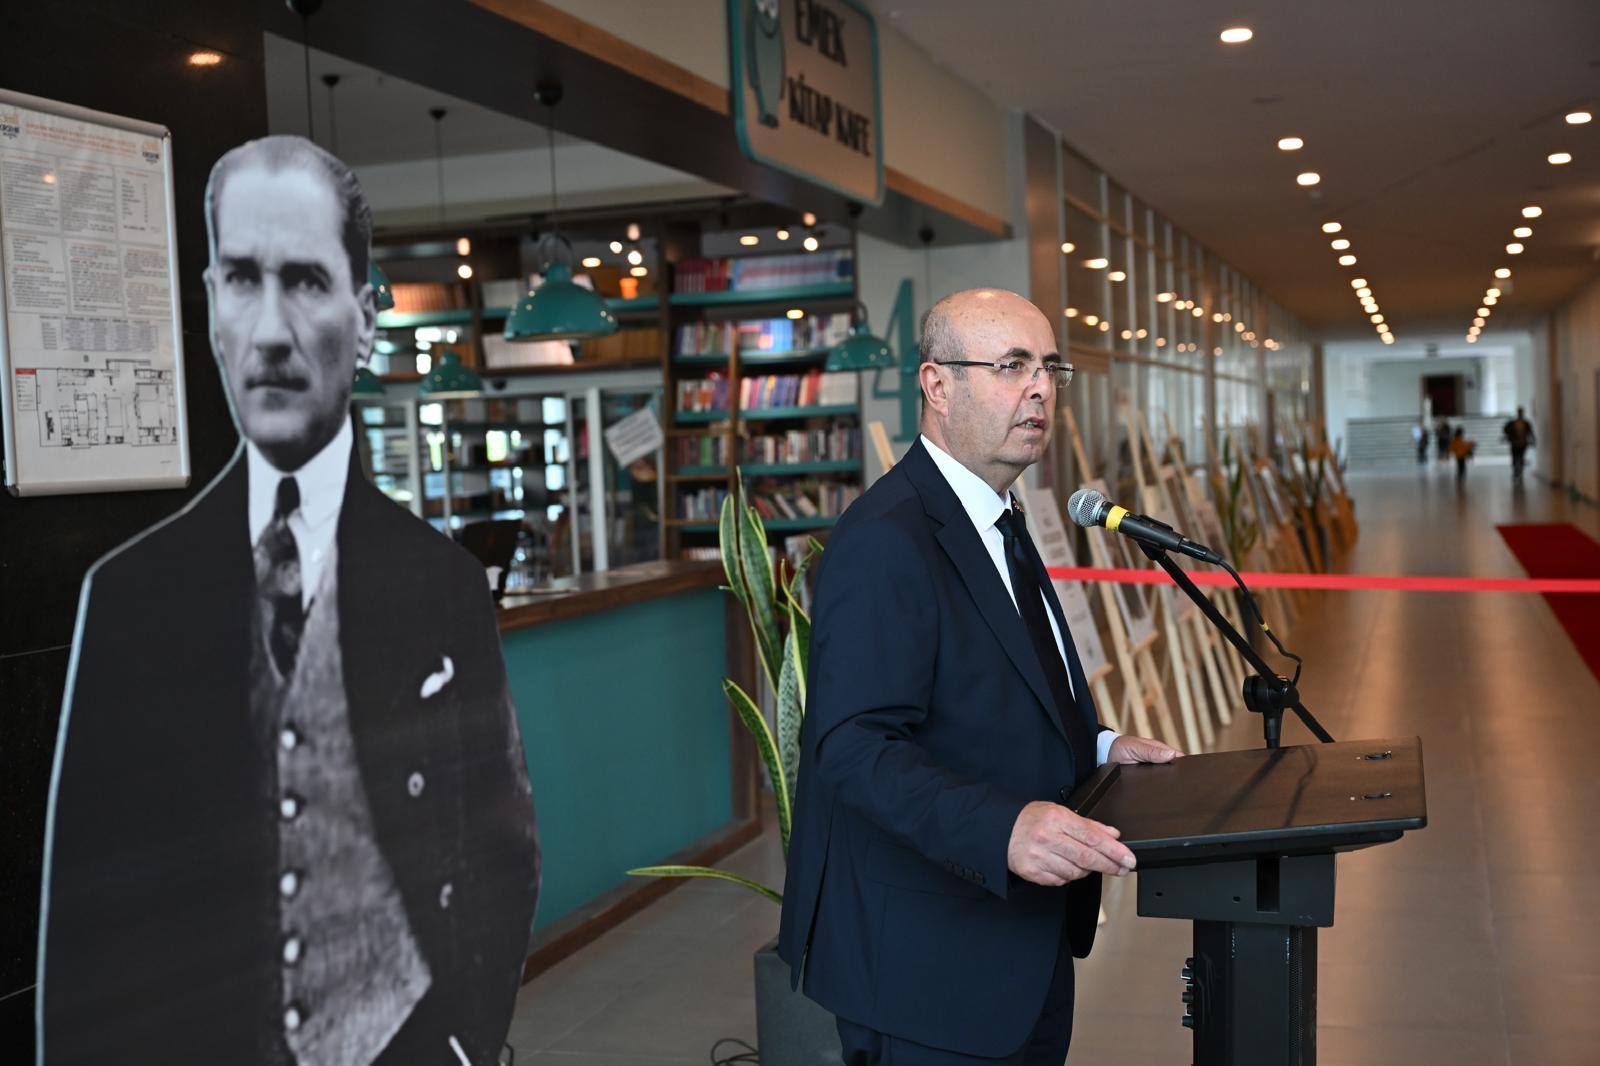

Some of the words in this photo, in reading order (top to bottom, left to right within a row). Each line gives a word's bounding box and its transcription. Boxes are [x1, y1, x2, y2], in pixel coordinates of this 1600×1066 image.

[794, 0, 848, 68] EMEK
[787, 72, 833, 136] KİTAP
[835, 102, 872, 158] KAFE
